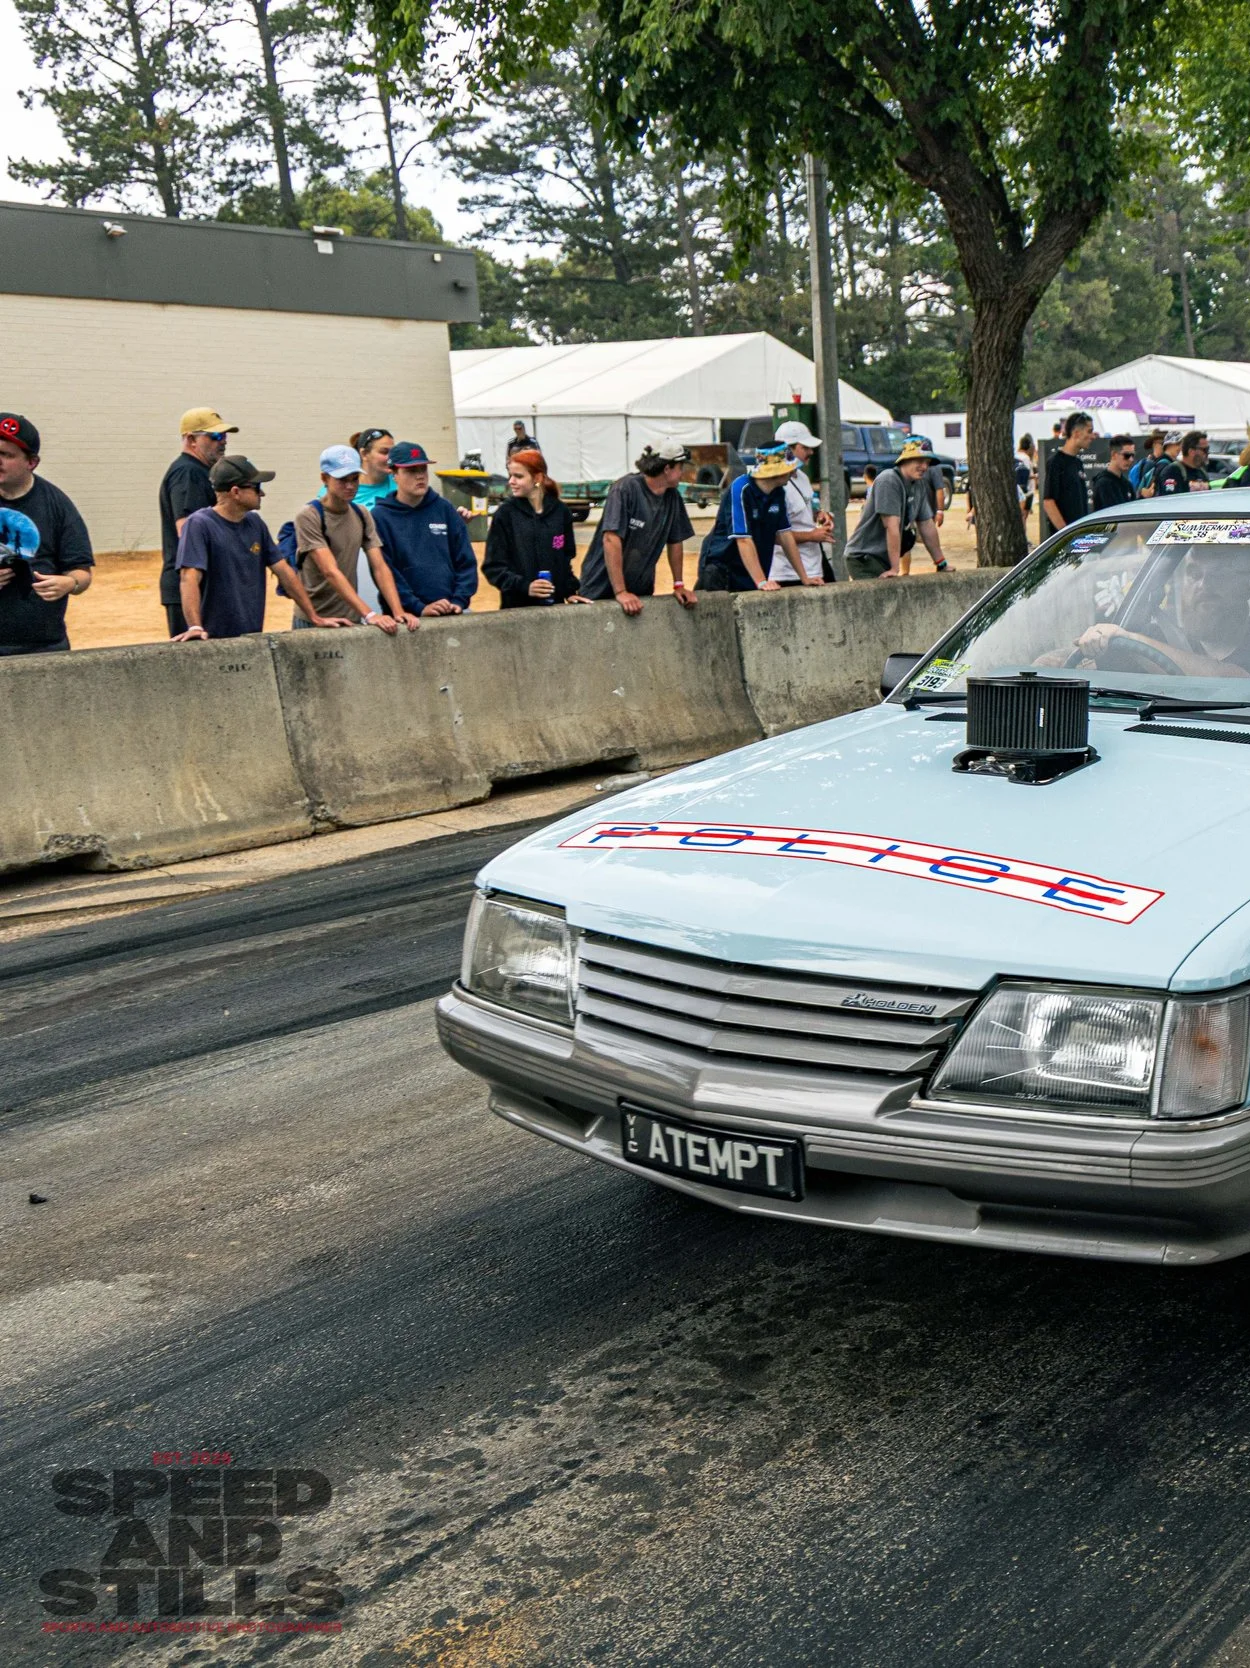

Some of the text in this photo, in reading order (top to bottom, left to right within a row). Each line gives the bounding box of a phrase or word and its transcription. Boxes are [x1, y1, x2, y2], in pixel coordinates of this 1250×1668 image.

[1176, 523, 1239, 532] SUMMERNATS
[916, 675, 947, 689] 3193
[588, 825, 1126, 911] POLICE
[864, 998, 937, 1016] HOLDEN
[626, 1114, 638, 1152] VIC
[649, 1120, 784, 1186] ATEMPT
